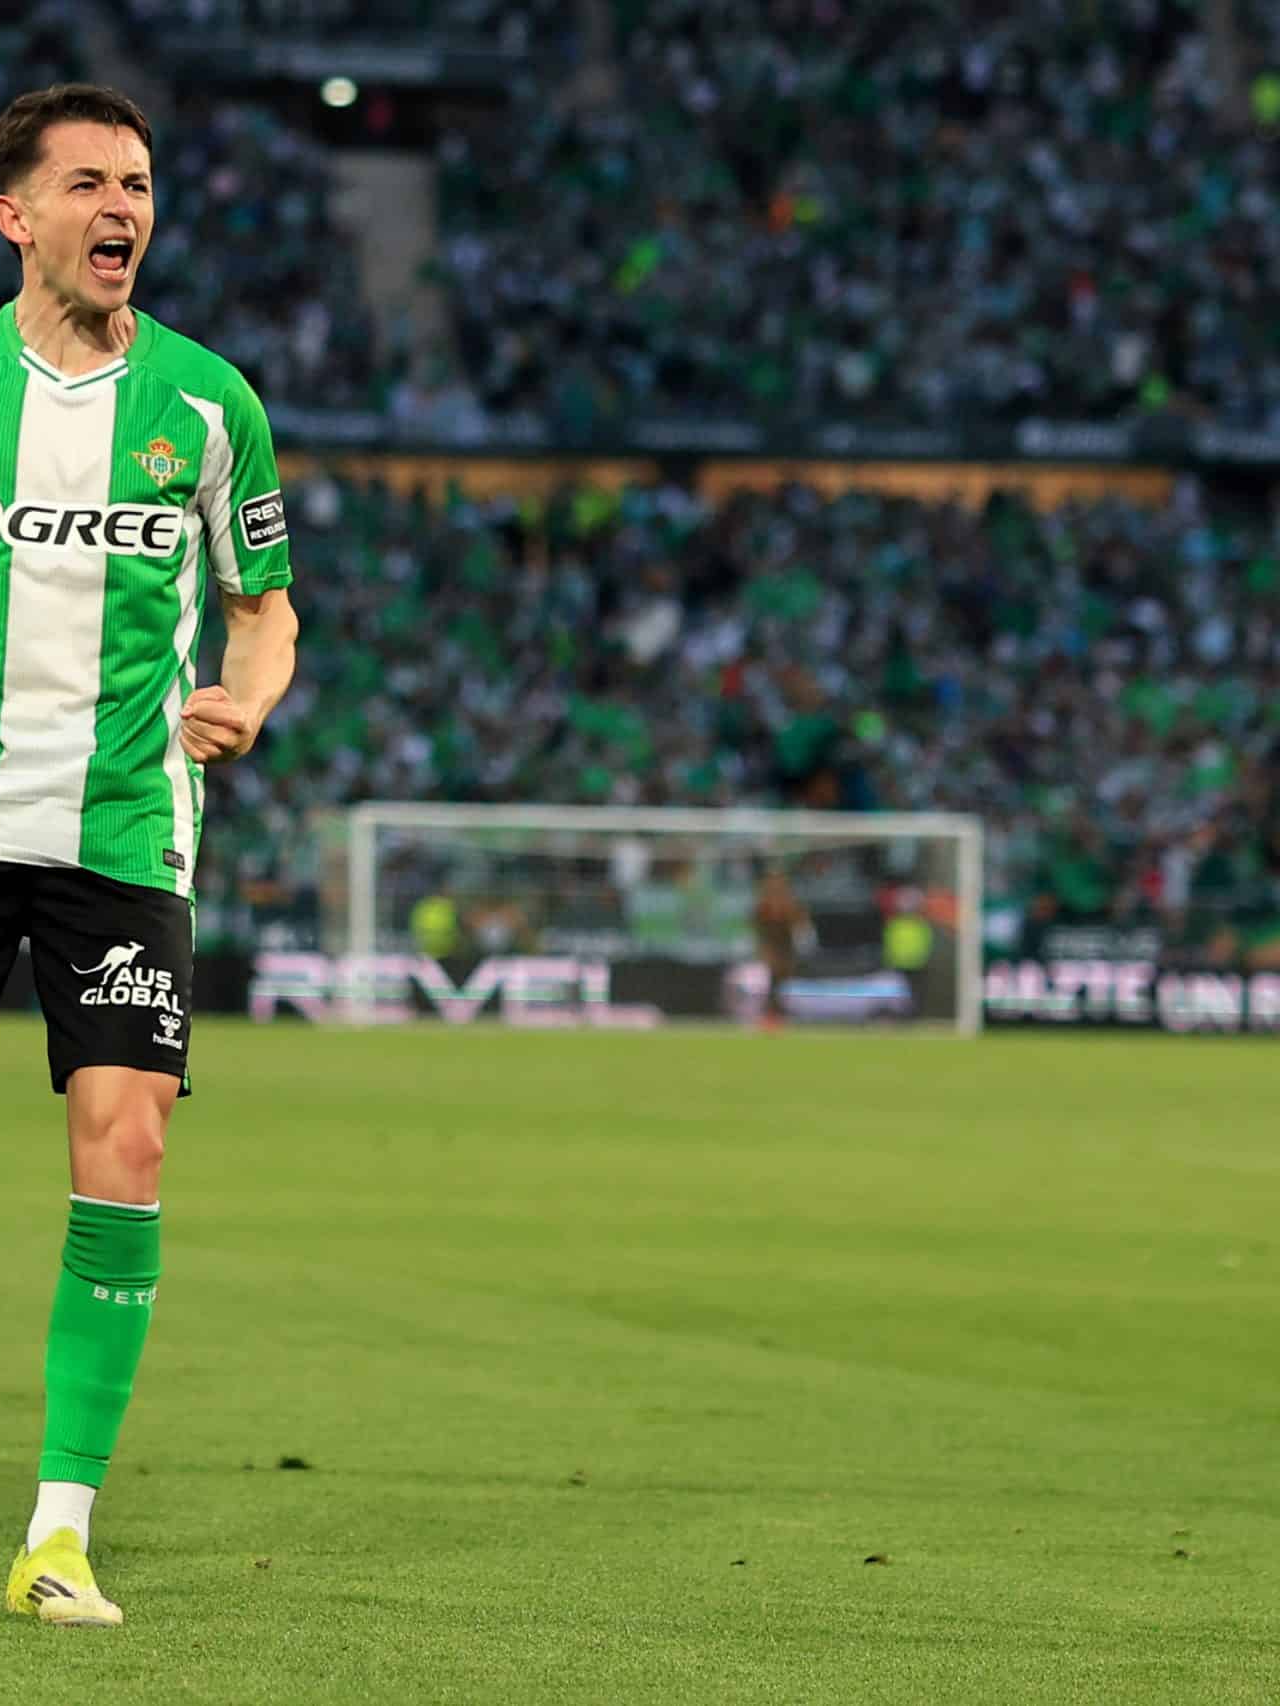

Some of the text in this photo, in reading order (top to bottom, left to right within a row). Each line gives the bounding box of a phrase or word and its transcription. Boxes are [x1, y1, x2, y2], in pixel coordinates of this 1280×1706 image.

[8, 506, 177, 549] GREE
[113, 967, 172, 990] AUS
[80, 986, 184, 1016] GLOBAL
